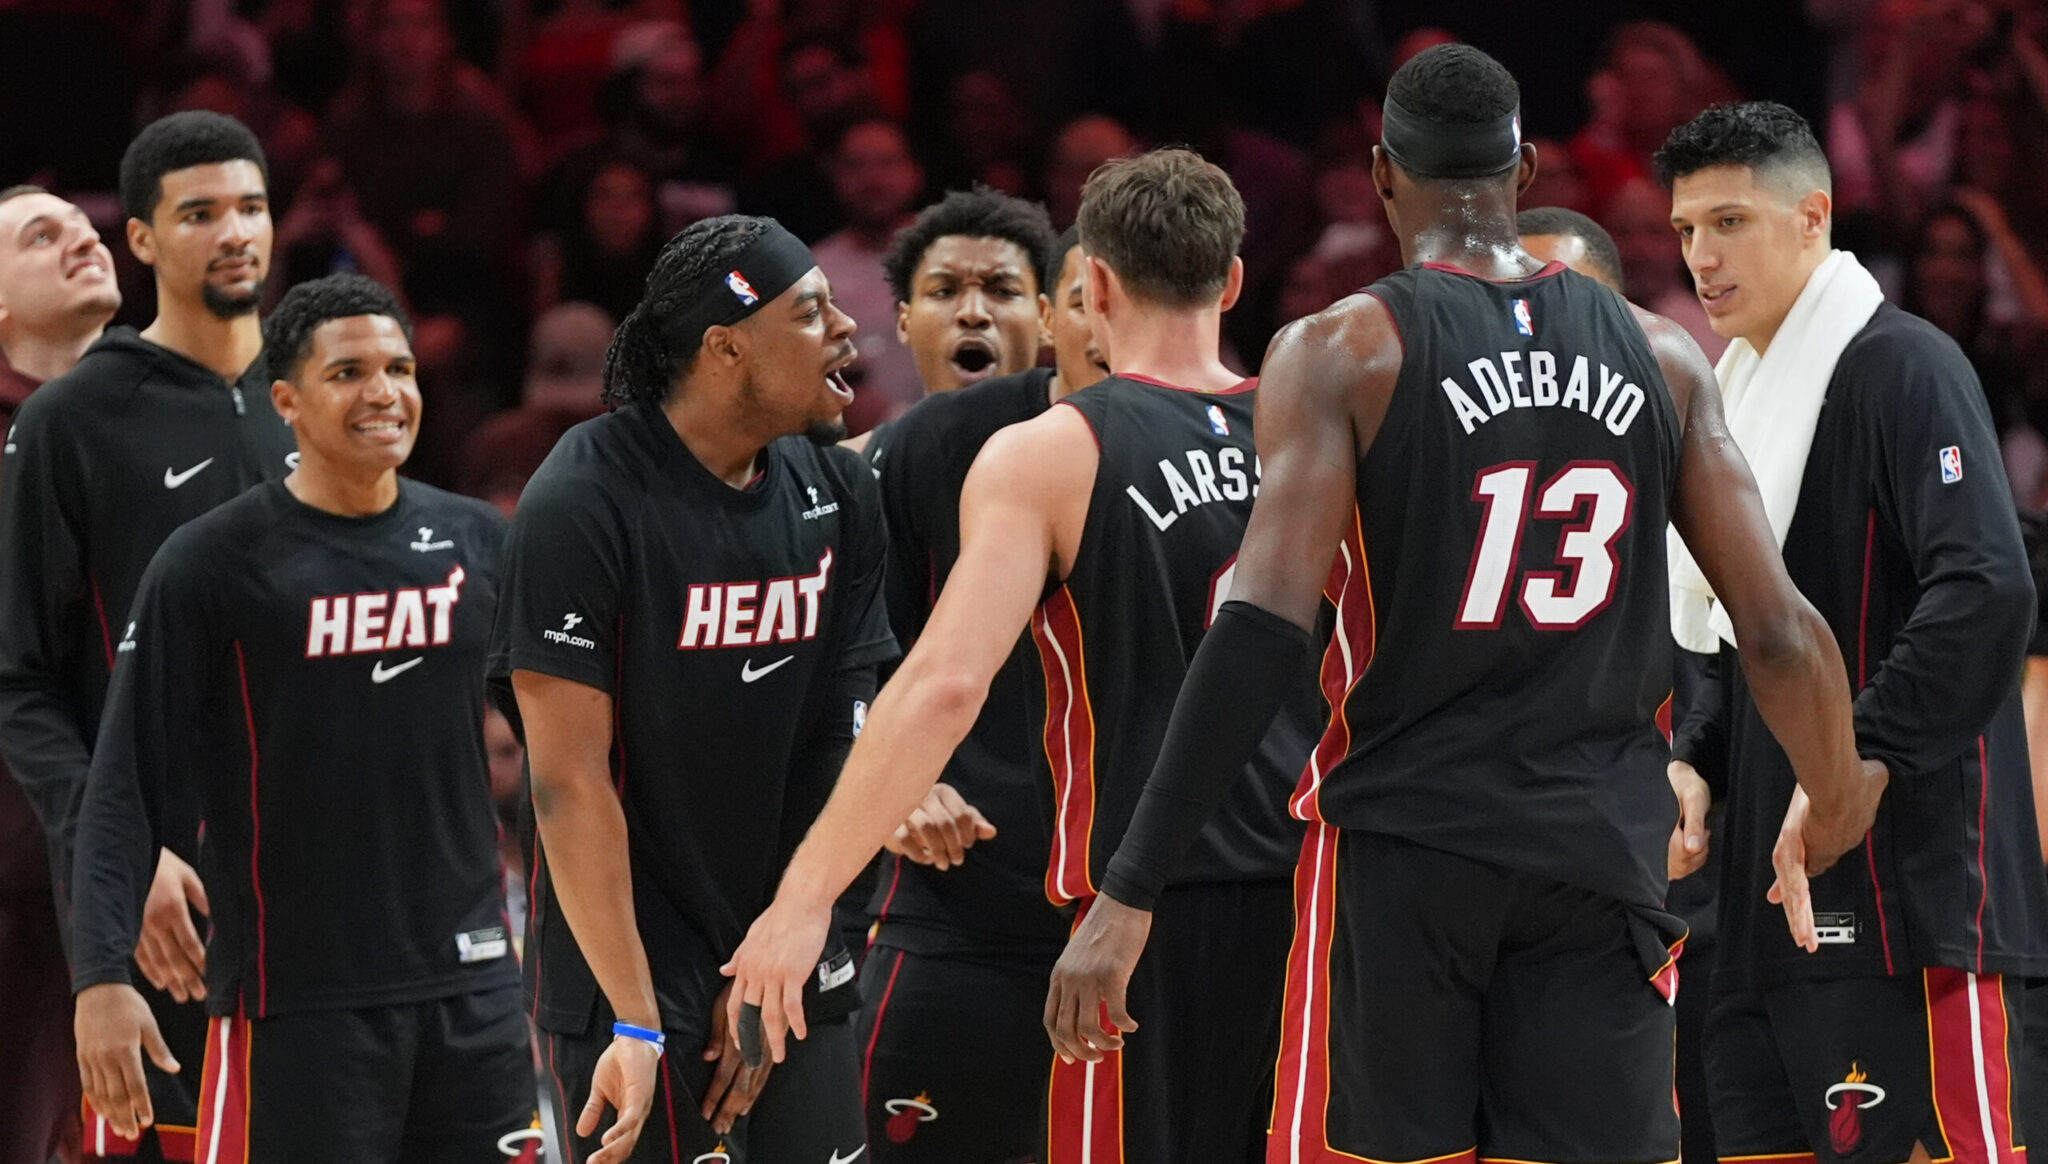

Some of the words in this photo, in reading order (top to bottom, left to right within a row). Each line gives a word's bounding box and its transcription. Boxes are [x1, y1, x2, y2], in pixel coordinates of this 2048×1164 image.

[1441, 350, 1646, 437] ADEBAYO
[1453, 459, 1636, 631] 13
[305, 564, 466, 658] HEAT
[543, 629, 596, 650] mph.com
[676, 545, 835, 649] HEAT
